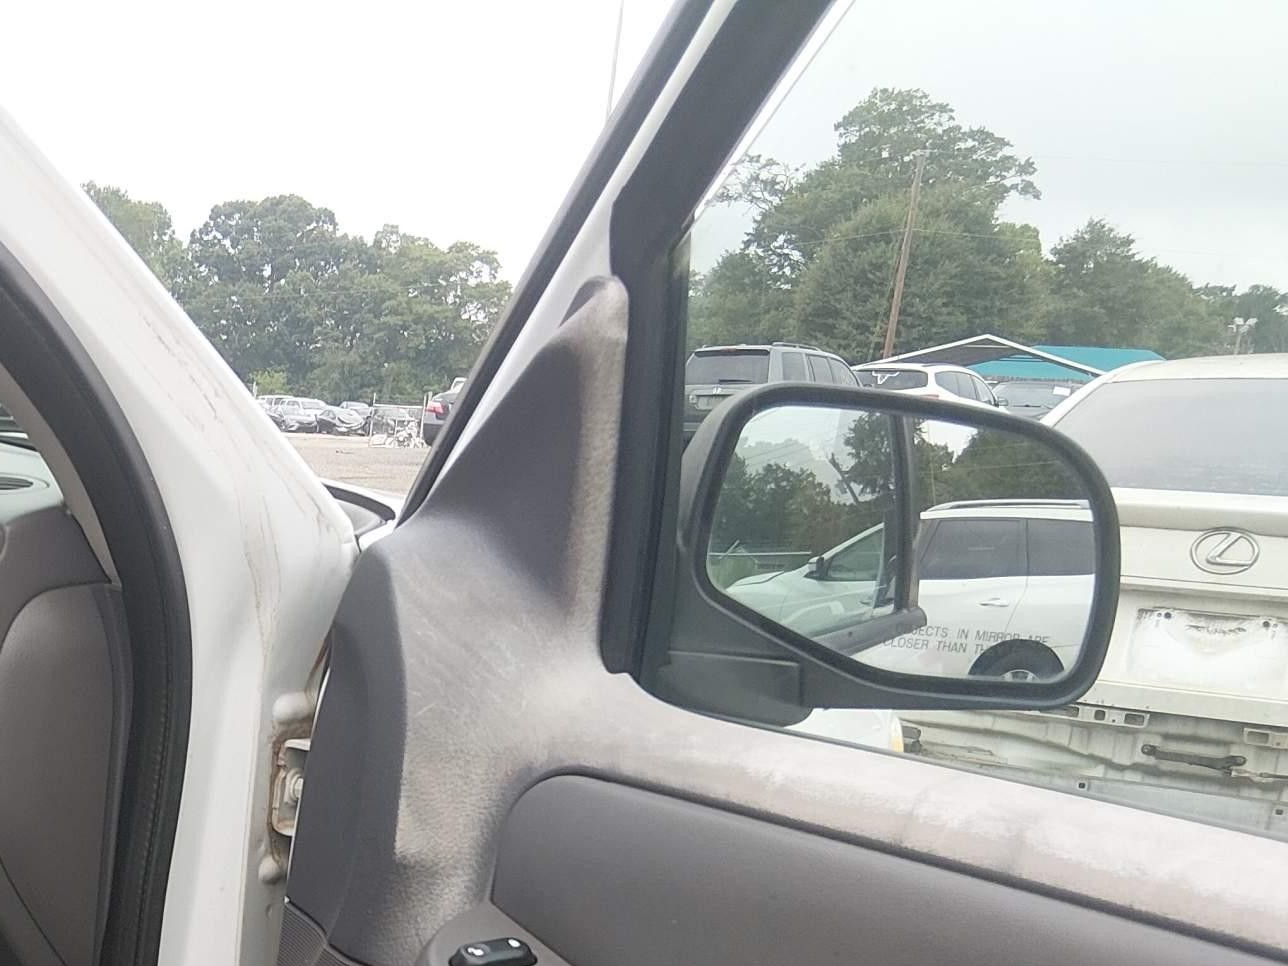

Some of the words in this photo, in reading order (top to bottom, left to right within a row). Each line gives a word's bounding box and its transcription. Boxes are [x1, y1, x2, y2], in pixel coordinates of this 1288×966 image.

[956, 628, 970, 640] IN
[975, 630, 1020, 643] MIRROR
[883, 637, 929, 650] CLOSER
[937, 640, 968, 654] THAN
